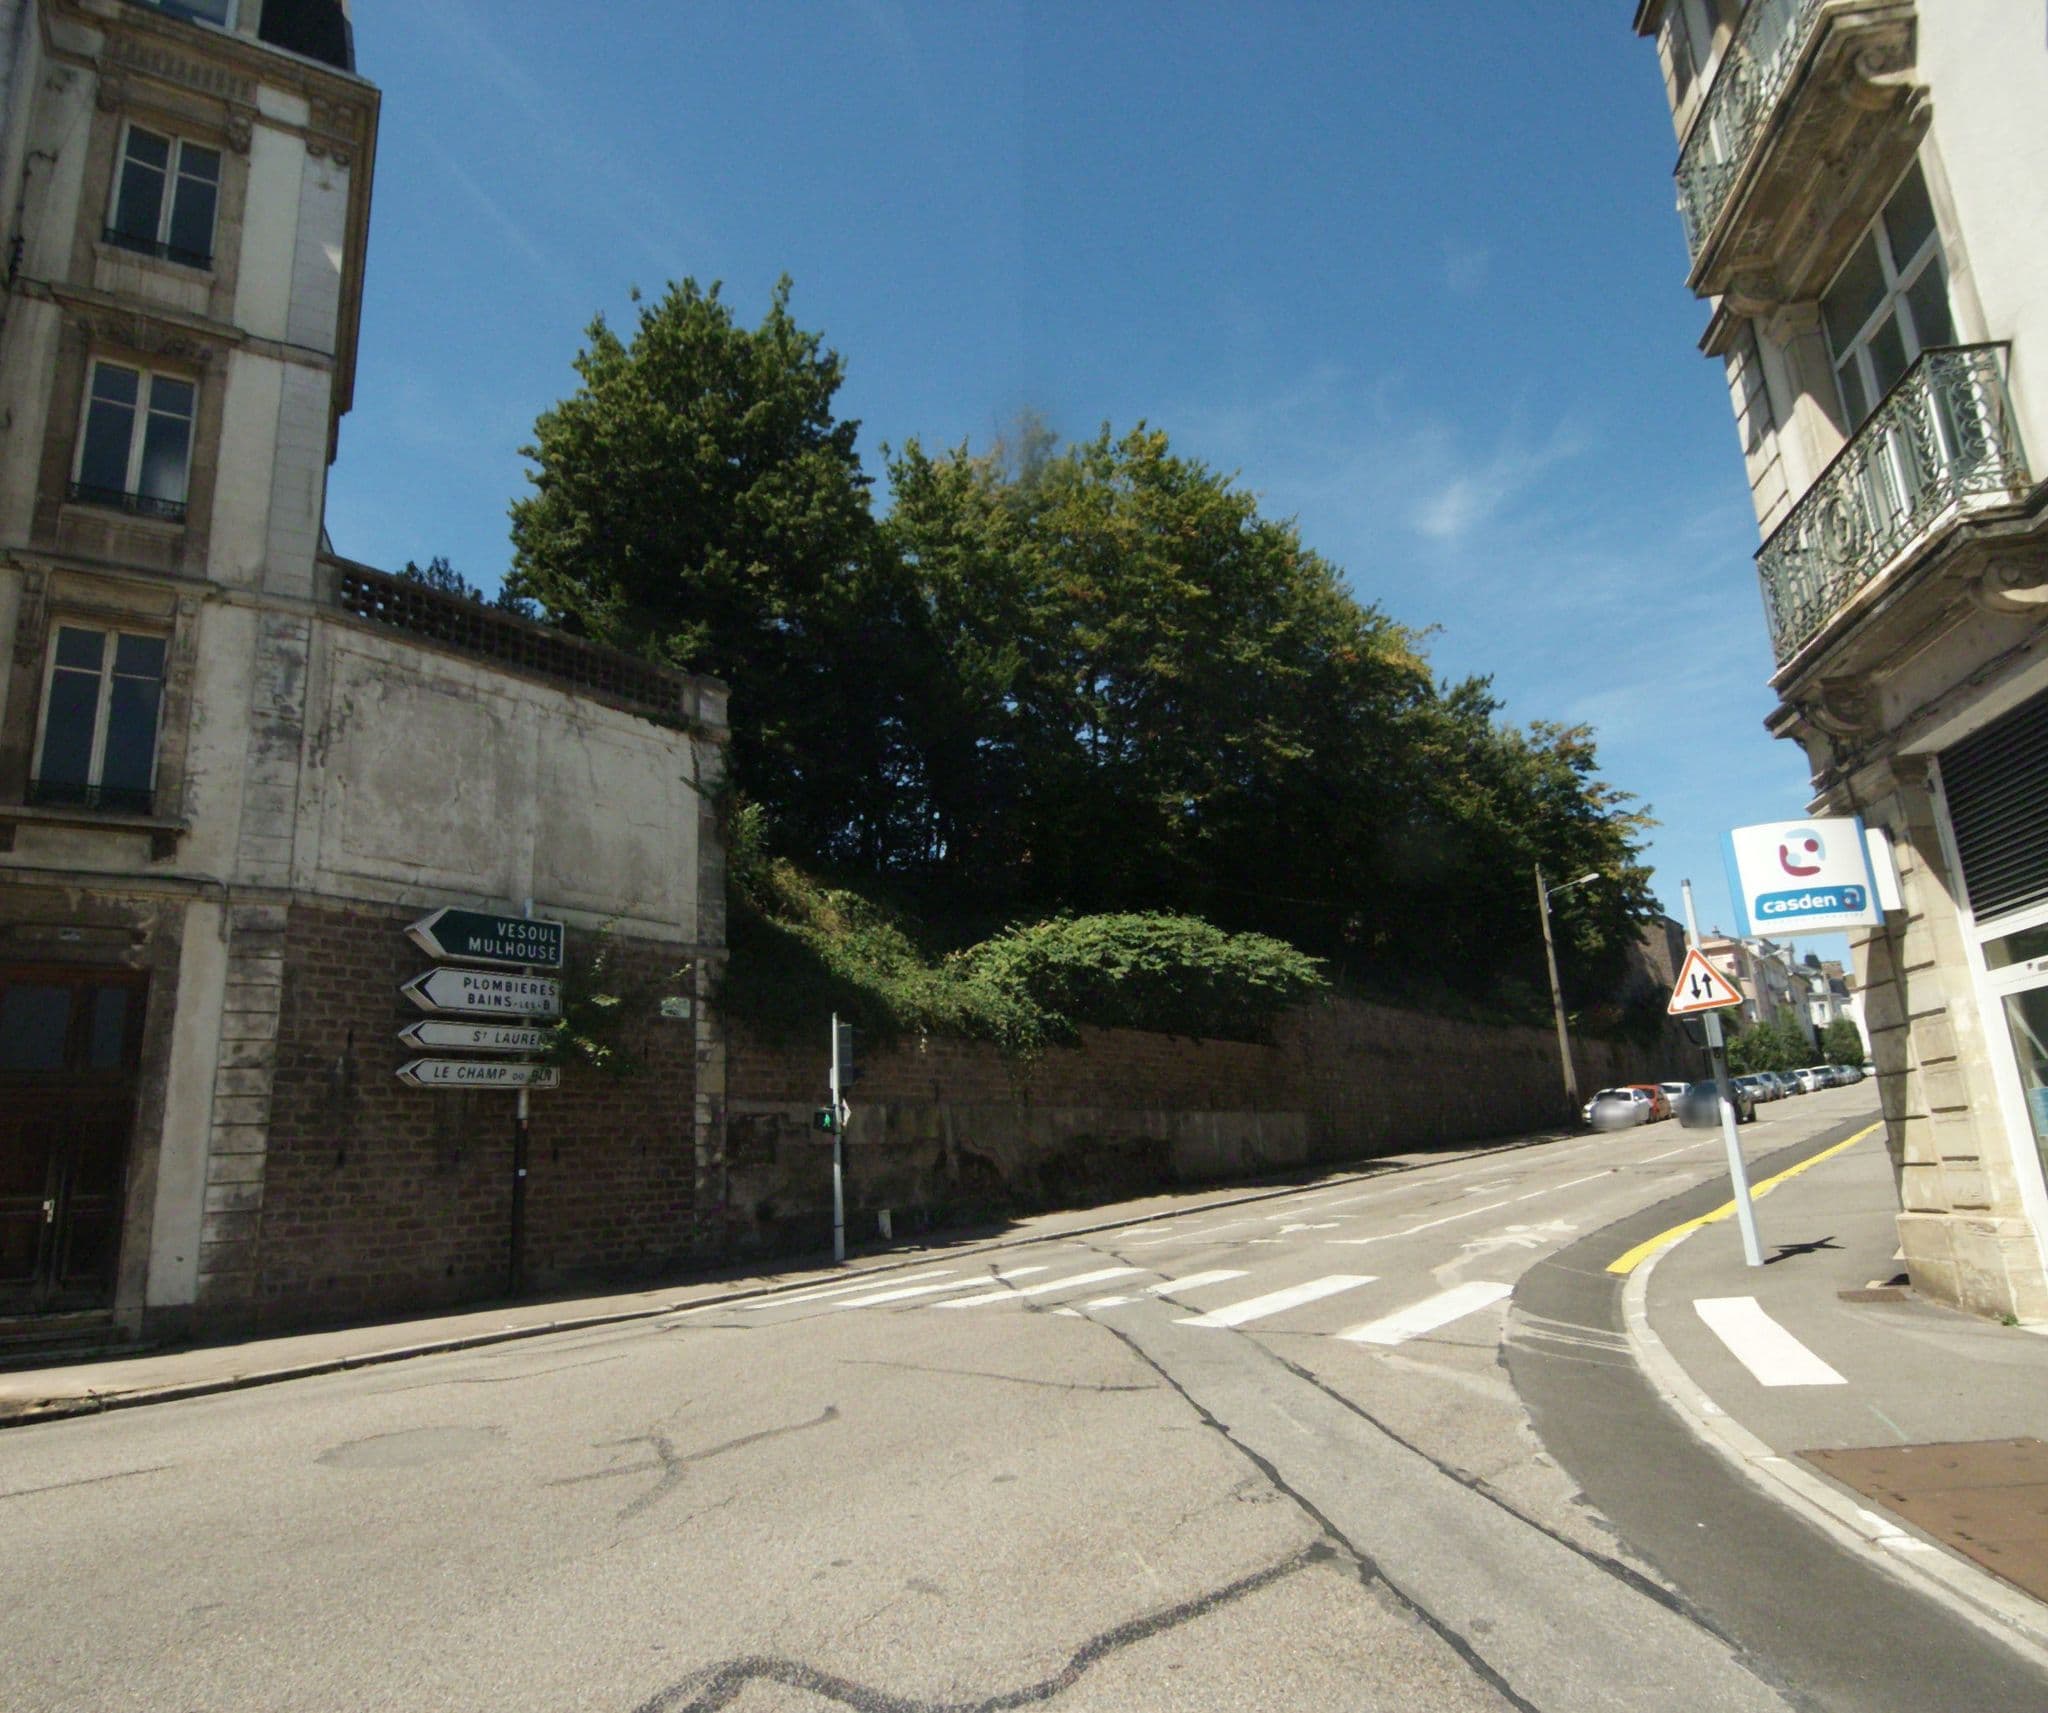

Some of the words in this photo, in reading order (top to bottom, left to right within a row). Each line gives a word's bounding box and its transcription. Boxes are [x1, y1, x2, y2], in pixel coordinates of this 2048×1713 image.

[1763, 893, 1837, 913] casden
[497, 921, 556, 943] VESOUL
[469, 936, 556, 961] MULHOUSE
[463, 977, 555, 996] PLOMBIERES
[495, 1032, 552, 1047] LAURE
[434, 1066, 449, 1079] LE
[457, 1067, 508, 1081] CHAMP
